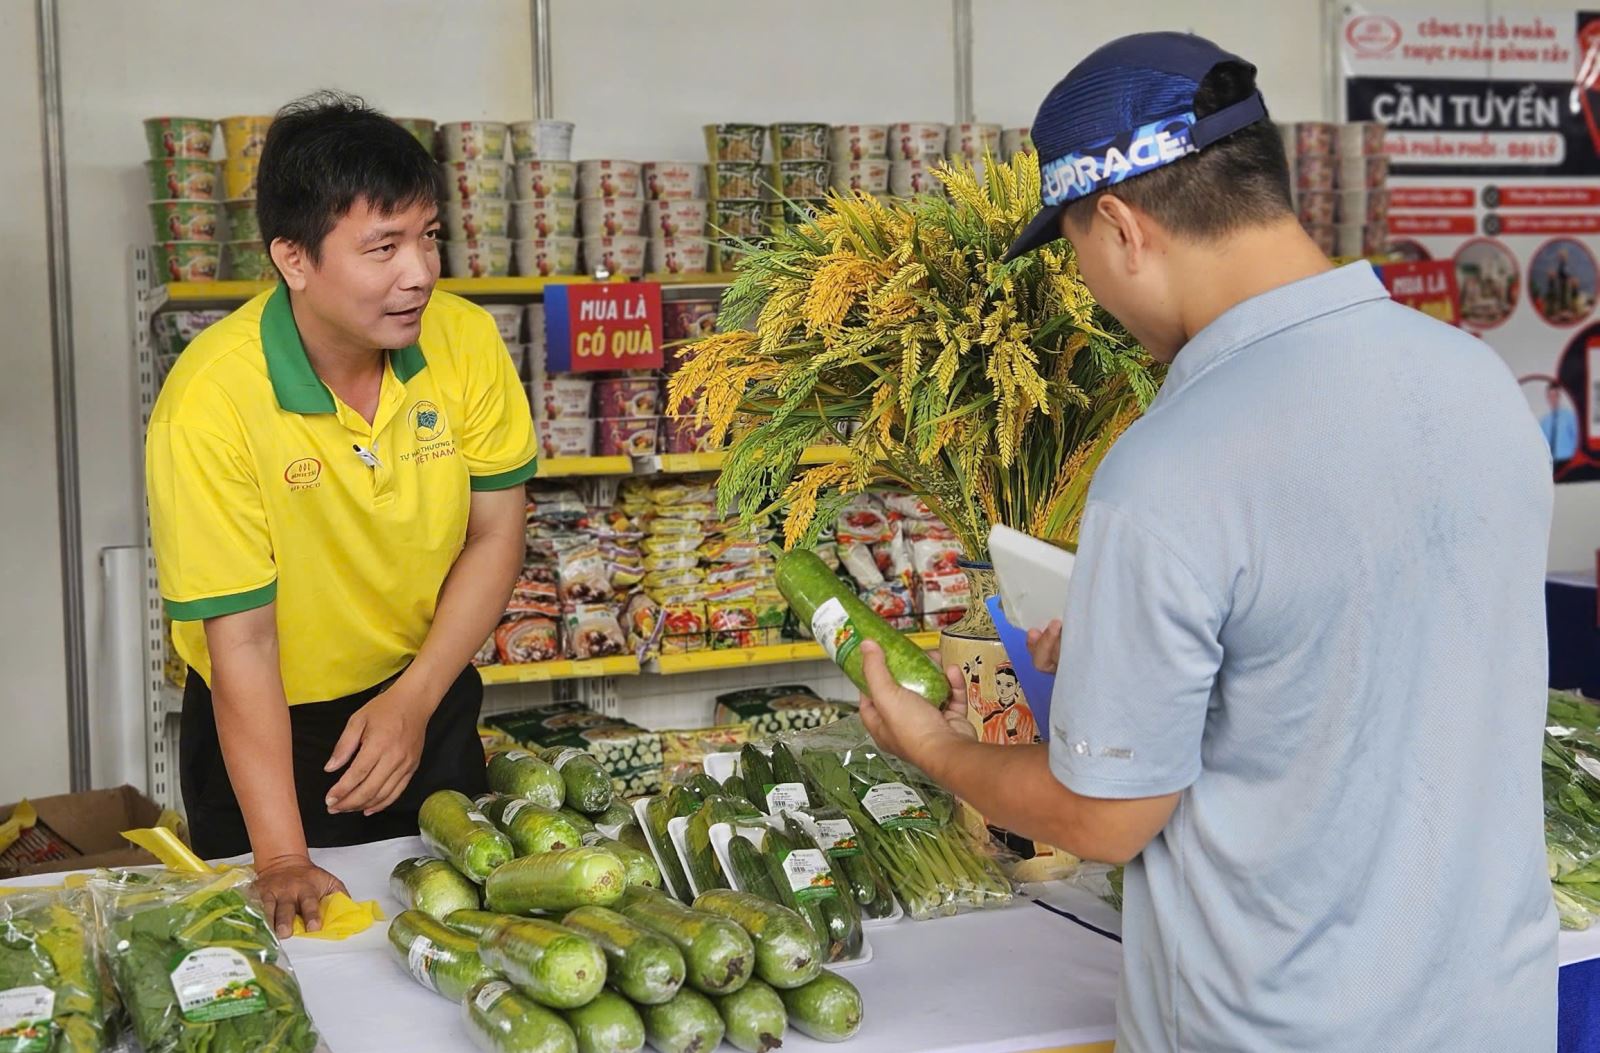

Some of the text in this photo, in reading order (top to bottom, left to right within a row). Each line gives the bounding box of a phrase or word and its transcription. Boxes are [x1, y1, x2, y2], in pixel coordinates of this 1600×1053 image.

[1044, 131, 1186, 197] UPRACE
[580, 294, 647, 321] MUA LÀ
[576, 323, 654, 358] CÓ QUÀ
[432, 446, 456, 460] NAM
